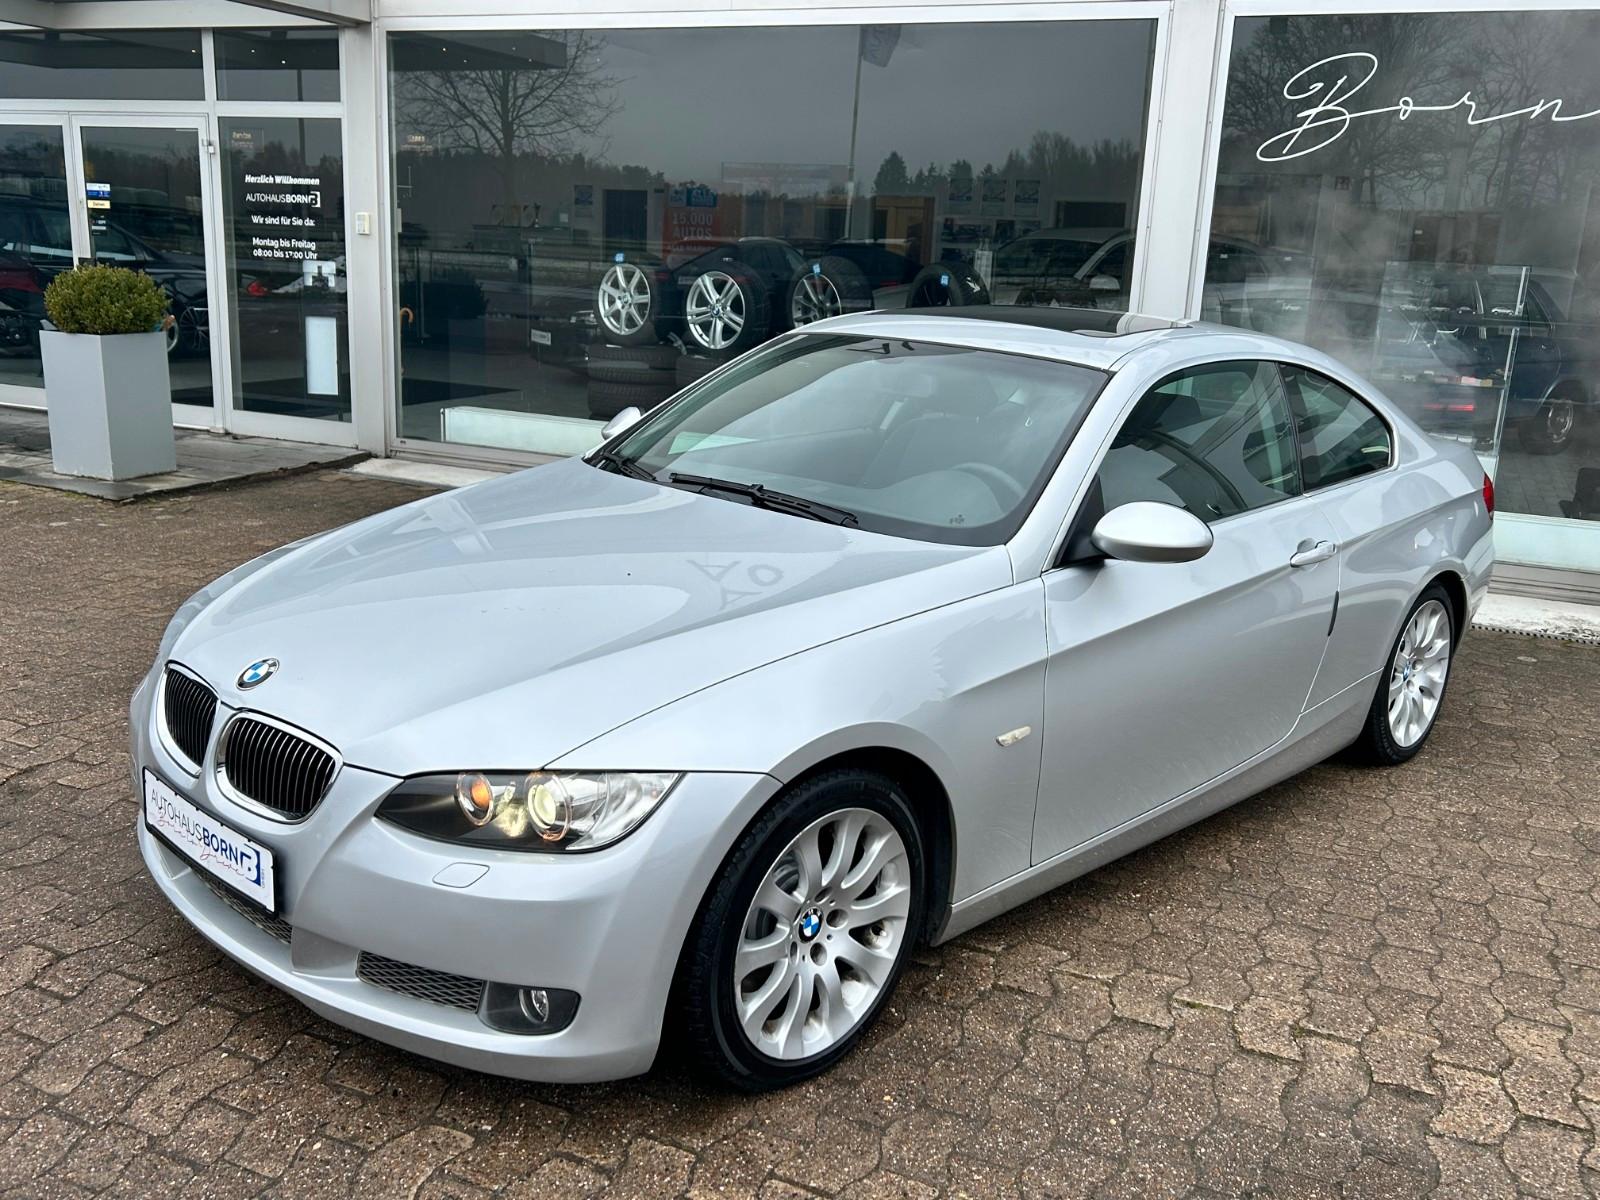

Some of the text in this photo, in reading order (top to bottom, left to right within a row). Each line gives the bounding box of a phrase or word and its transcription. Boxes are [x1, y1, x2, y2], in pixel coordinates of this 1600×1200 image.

[1256, 52, 1600, 162] Born
[245, 174, 320, 185] Herzlich Willkommen
[251, 215, 315, 226] Wir sind für Sie da:
[252, 237, 316, 250] Montag bis Freitag
[253, 248, 272, 257] 08:00
[273, 249, 284, 258] bis
[304, 251, 318, 260] Uhr
